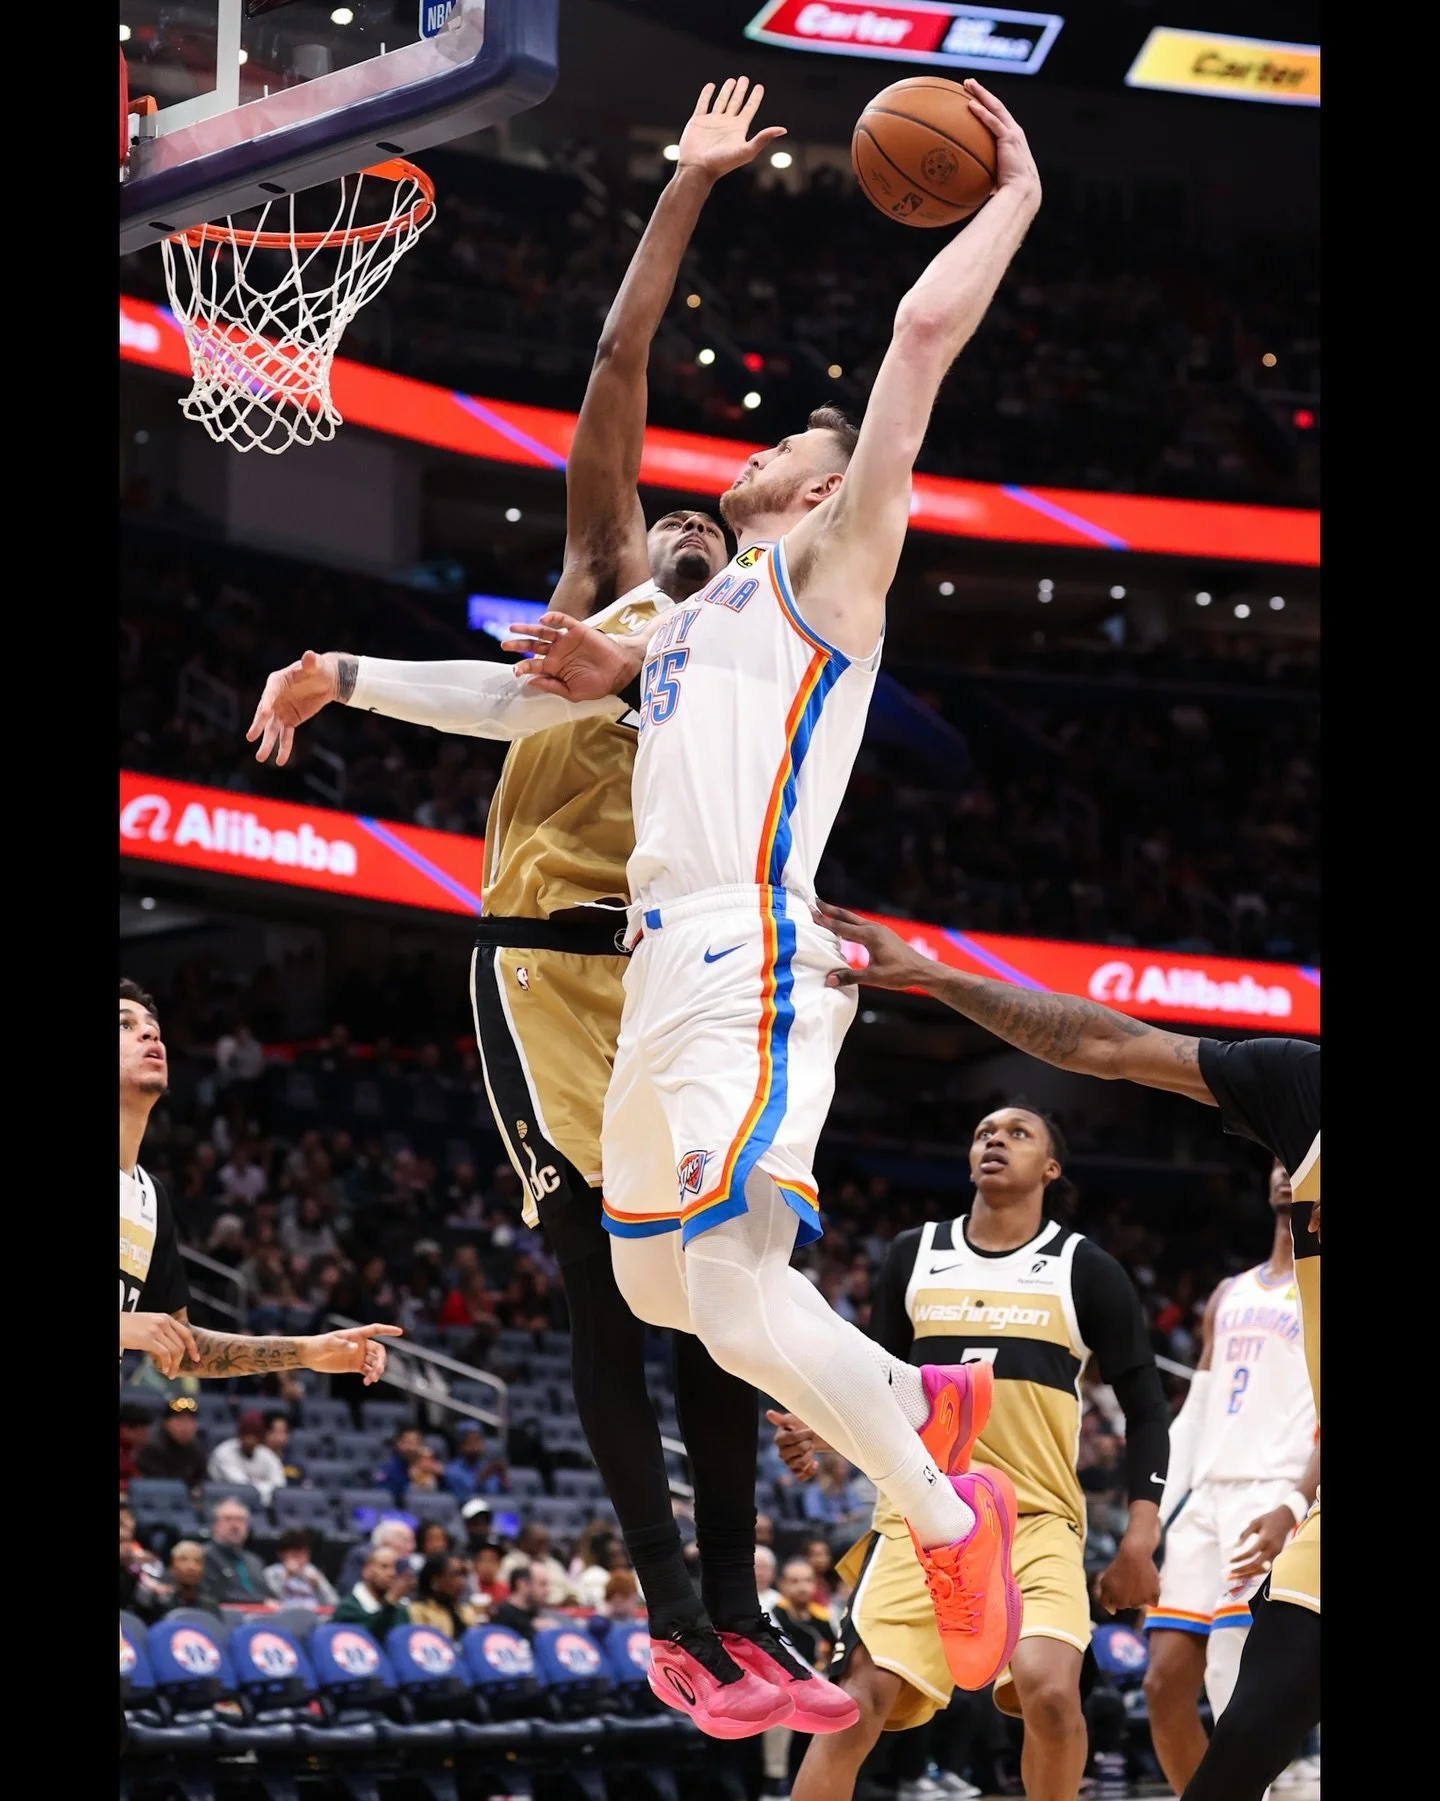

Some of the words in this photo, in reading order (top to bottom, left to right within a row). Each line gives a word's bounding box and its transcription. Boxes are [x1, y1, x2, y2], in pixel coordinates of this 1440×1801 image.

[427, 1, 452, 32] NBA
[638, 648, 690, 736] 55
[174, 802, 357, 876] Alibaba
[1136, 965, 1291, 1017] Alibaba
[914, 1296, 1050, 1330] washington
[1225, 1335, 1267, 1362] CITY
[1226, 1366, 1249, 1416] 2
